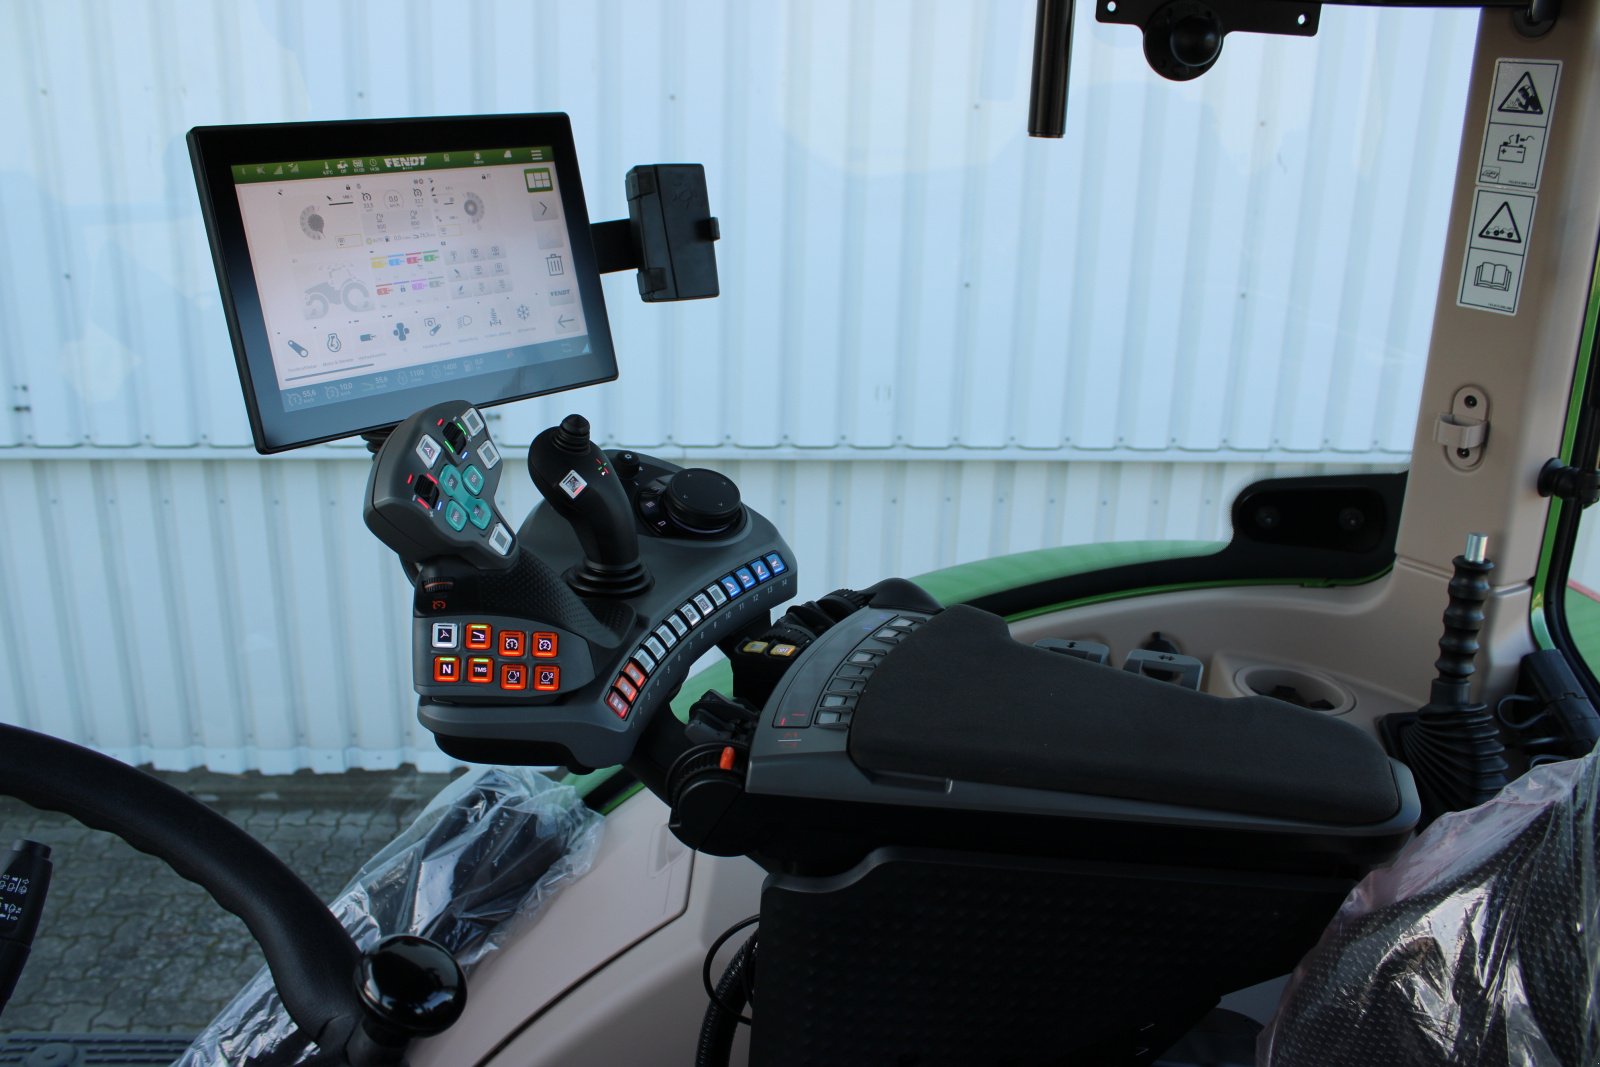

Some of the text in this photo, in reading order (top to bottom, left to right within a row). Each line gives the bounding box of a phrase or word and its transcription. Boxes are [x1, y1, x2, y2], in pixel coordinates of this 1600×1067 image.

[384, 156, 427, 168] FENDT
[550, 289, 571, 297] FENDT
[442, 664, 451, 674] N
